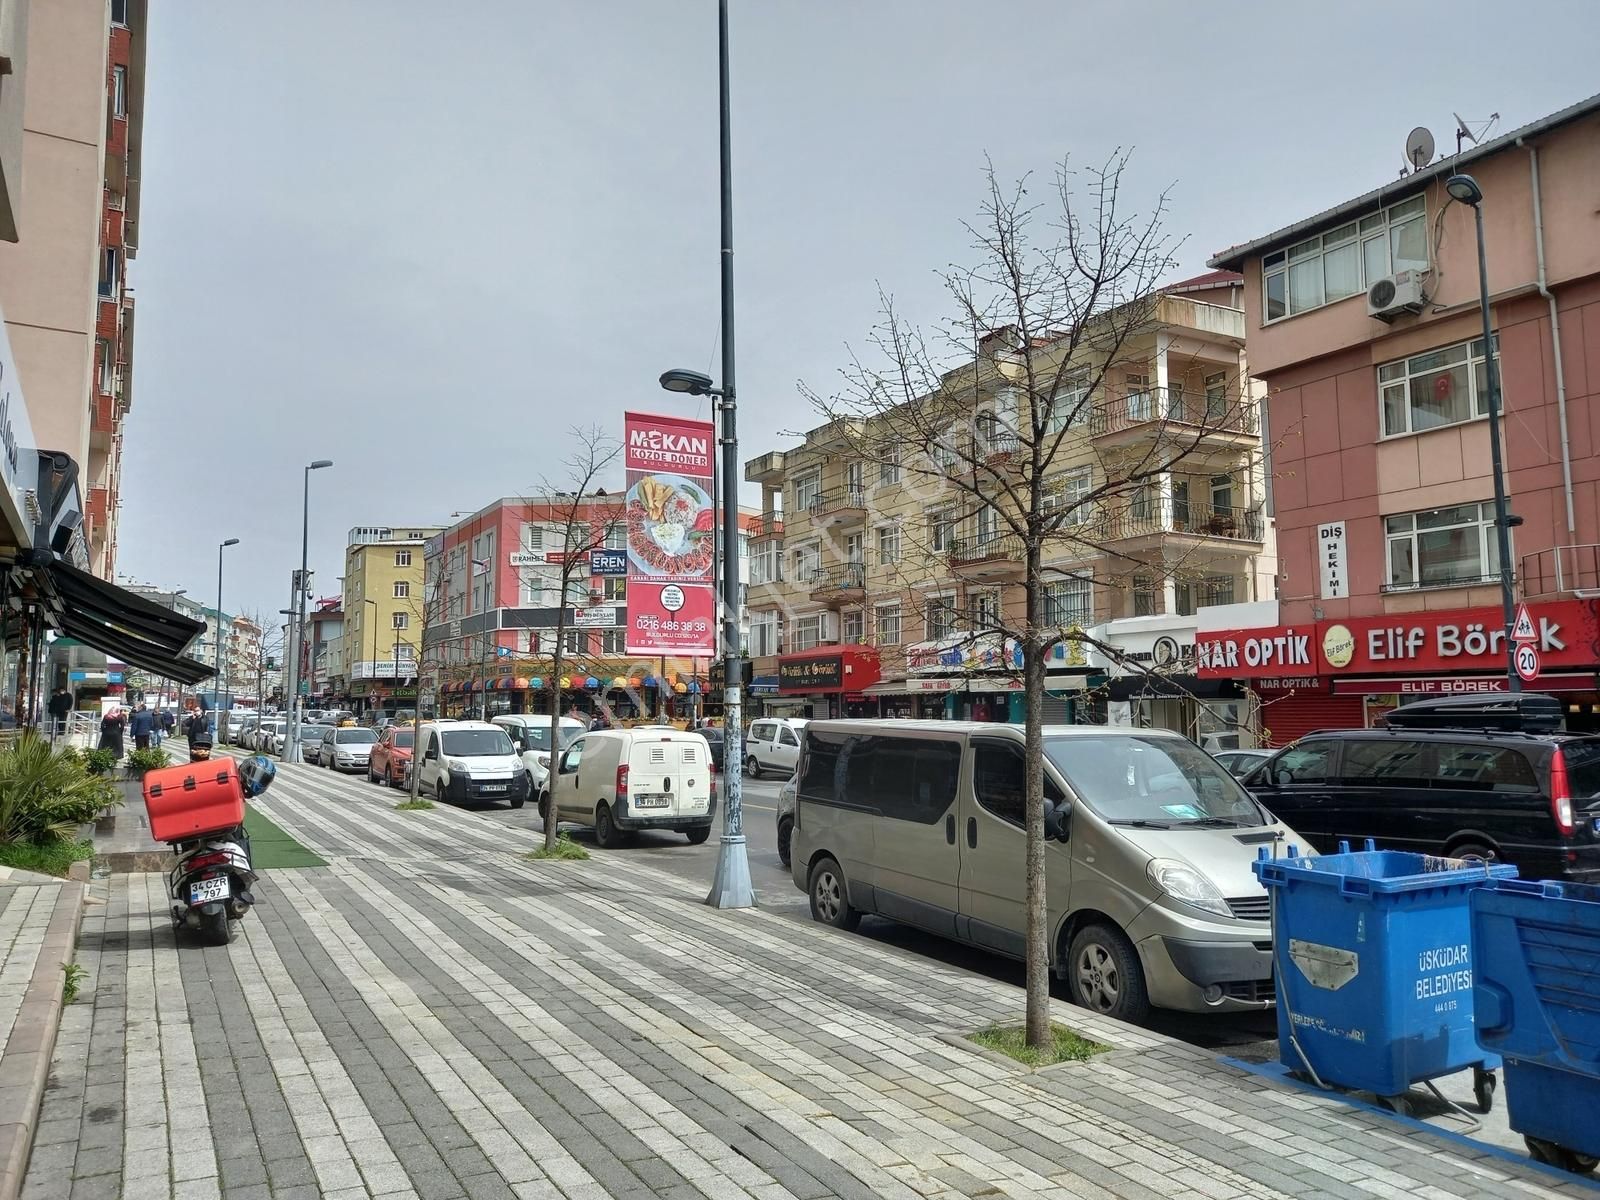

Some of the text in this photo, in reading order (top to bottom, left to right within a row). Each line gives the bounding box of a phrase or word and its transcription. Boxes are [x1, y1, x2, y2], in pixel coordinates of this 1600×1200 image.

[1320, 525, 1342, 539] DİŞ
[592, 557, 625, 568] EREN
[1327, 543, 1340, 596] HEKİMİ
[636, 619, 706, 632] 0216 486 38 38
[1367, 616, 1566, 661] Elif Börk
[1197, 639, 1239, 668] NAR
[1244, 628, 1310, 667] OPTİK
[1520, 652, 1535, 671] 20
[1260, 677, 1320, 689] NAR OPTİK &
[1401, 679, 1502, 693] ELİF BÖREK
[191, 877, 226, 892] 34 CZR
[203, 888, 221, 899] 797
[1419, 944, 1468, 972] ÜSKÜDAR
[1416, 969, 1473, 1000] BELEDİYESİ
